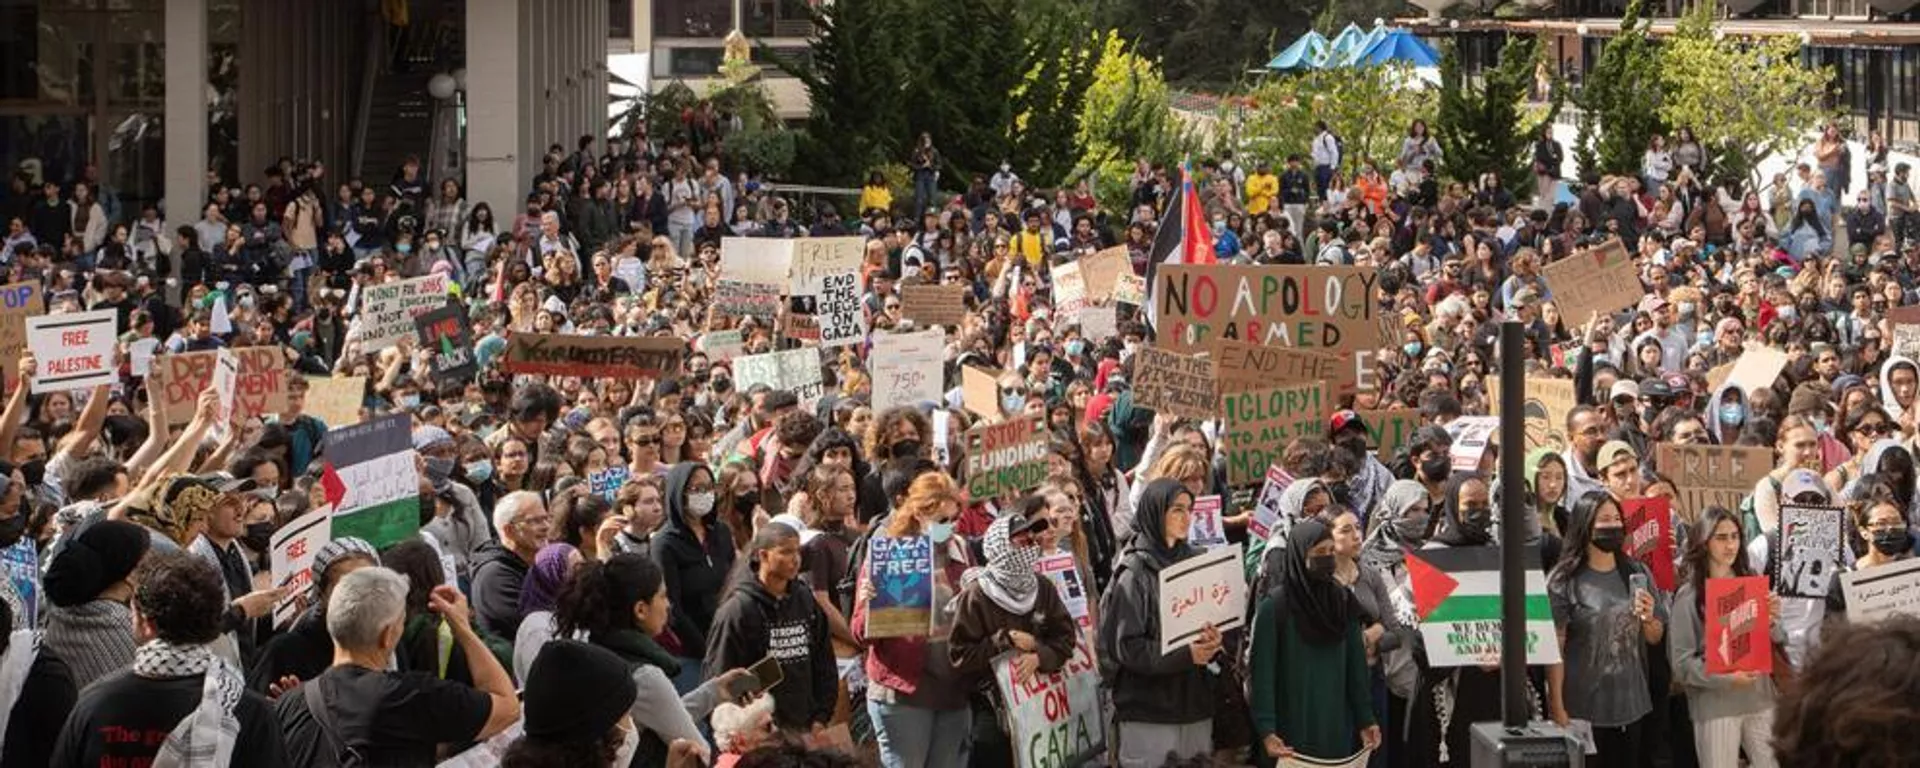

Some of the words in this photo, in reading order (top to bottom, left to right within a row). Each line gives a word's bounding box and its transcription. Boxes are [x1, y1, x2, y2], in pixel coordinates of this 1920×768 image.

[823, 273, 856, 289] END
[0, 285, 34, 308] OP
[822, 287, 856, 302] THE
[1164, 271, 1218, 319] NO
[1230, 271, 1378, 320] APOLOGY
[819, 299, 861, 316] SIEGE
[378, 310, 403, 323] NOT
[831, 313, 854, 327] ON
[61, 330, 90, 347] FREE
[822, 324, 862, 341] GAZA
[1171, 322, 1210, 346] for
[1223, 321, 1341, 347] ARMED
[47, 354, 103, 374] PALESTINE
[1141, 350, 1181, 370] FROM
[1183, 357, 1212, 376] THE
[1218, 346, 1279, 372] END
[1285, 350, 1340, 379] THE
[984, 418, 1026, 450] STOP
[1228, 429, 1254, 447] TO
[1260, 424, 1289, 443] ALL
[1293, 418, 1323, 437] THE
[968, 440, 1046, 476] FUNDING
[871, 535, 930, 552] GAZA
[872, 551, 909, 560] WILL
[911, 548, 928, 558] BE
[872, 558, 931, 576] FREE
[769, 625, 806, 639] STRONG
[1452, 621, 1471, 633] WE
[1446, 631, 1487, 645] EQUAL
[1455, 643, 1481, 655] AND
[1043, 689, 1072, 723] ON
[98, 725, 141, 743] The
[1029, 712, 1093, 768] GAZA
